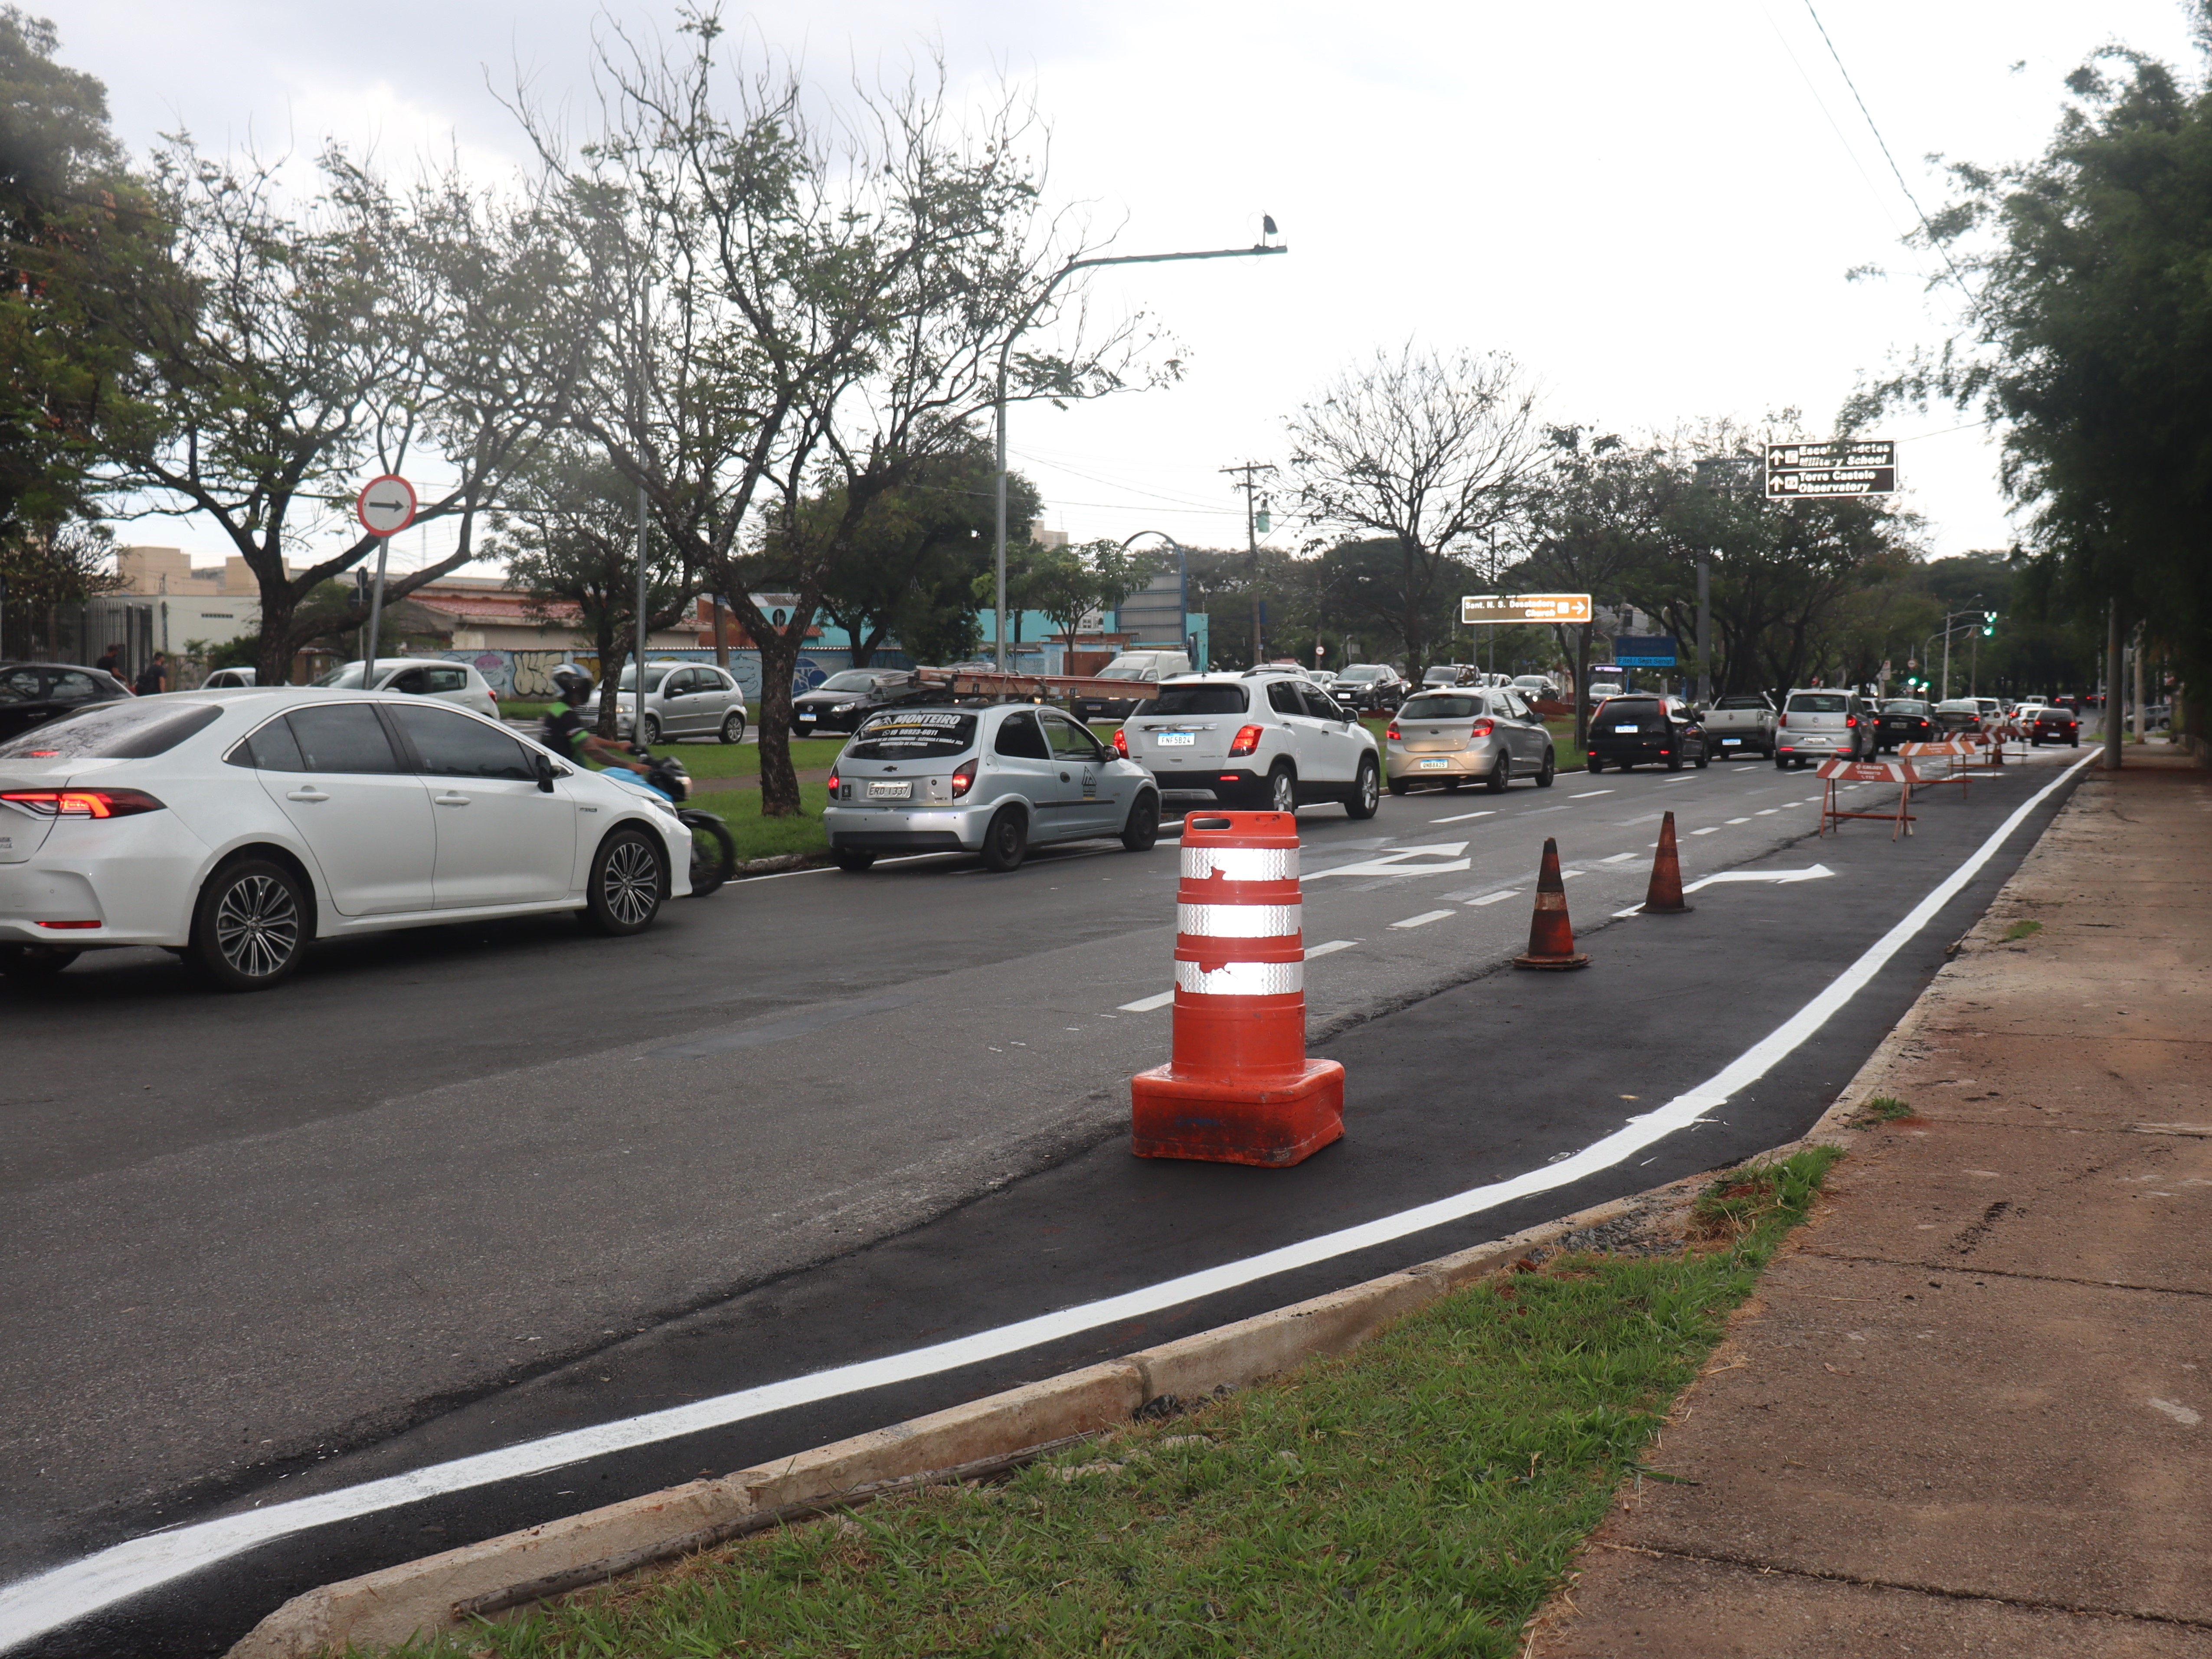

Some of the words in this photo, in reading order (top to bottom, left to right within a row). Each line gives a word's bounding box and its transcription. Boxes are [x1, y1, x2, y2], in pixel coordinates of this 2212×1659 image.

[1847, 455, 1887, 465] School
[1799, 472, 1829, 482] Torre
[1832, 471, 1876, 481] Castelo
[1799, 483, 1870, 493] Observatory
[893, 714, 961, 725] MONTEIRO
